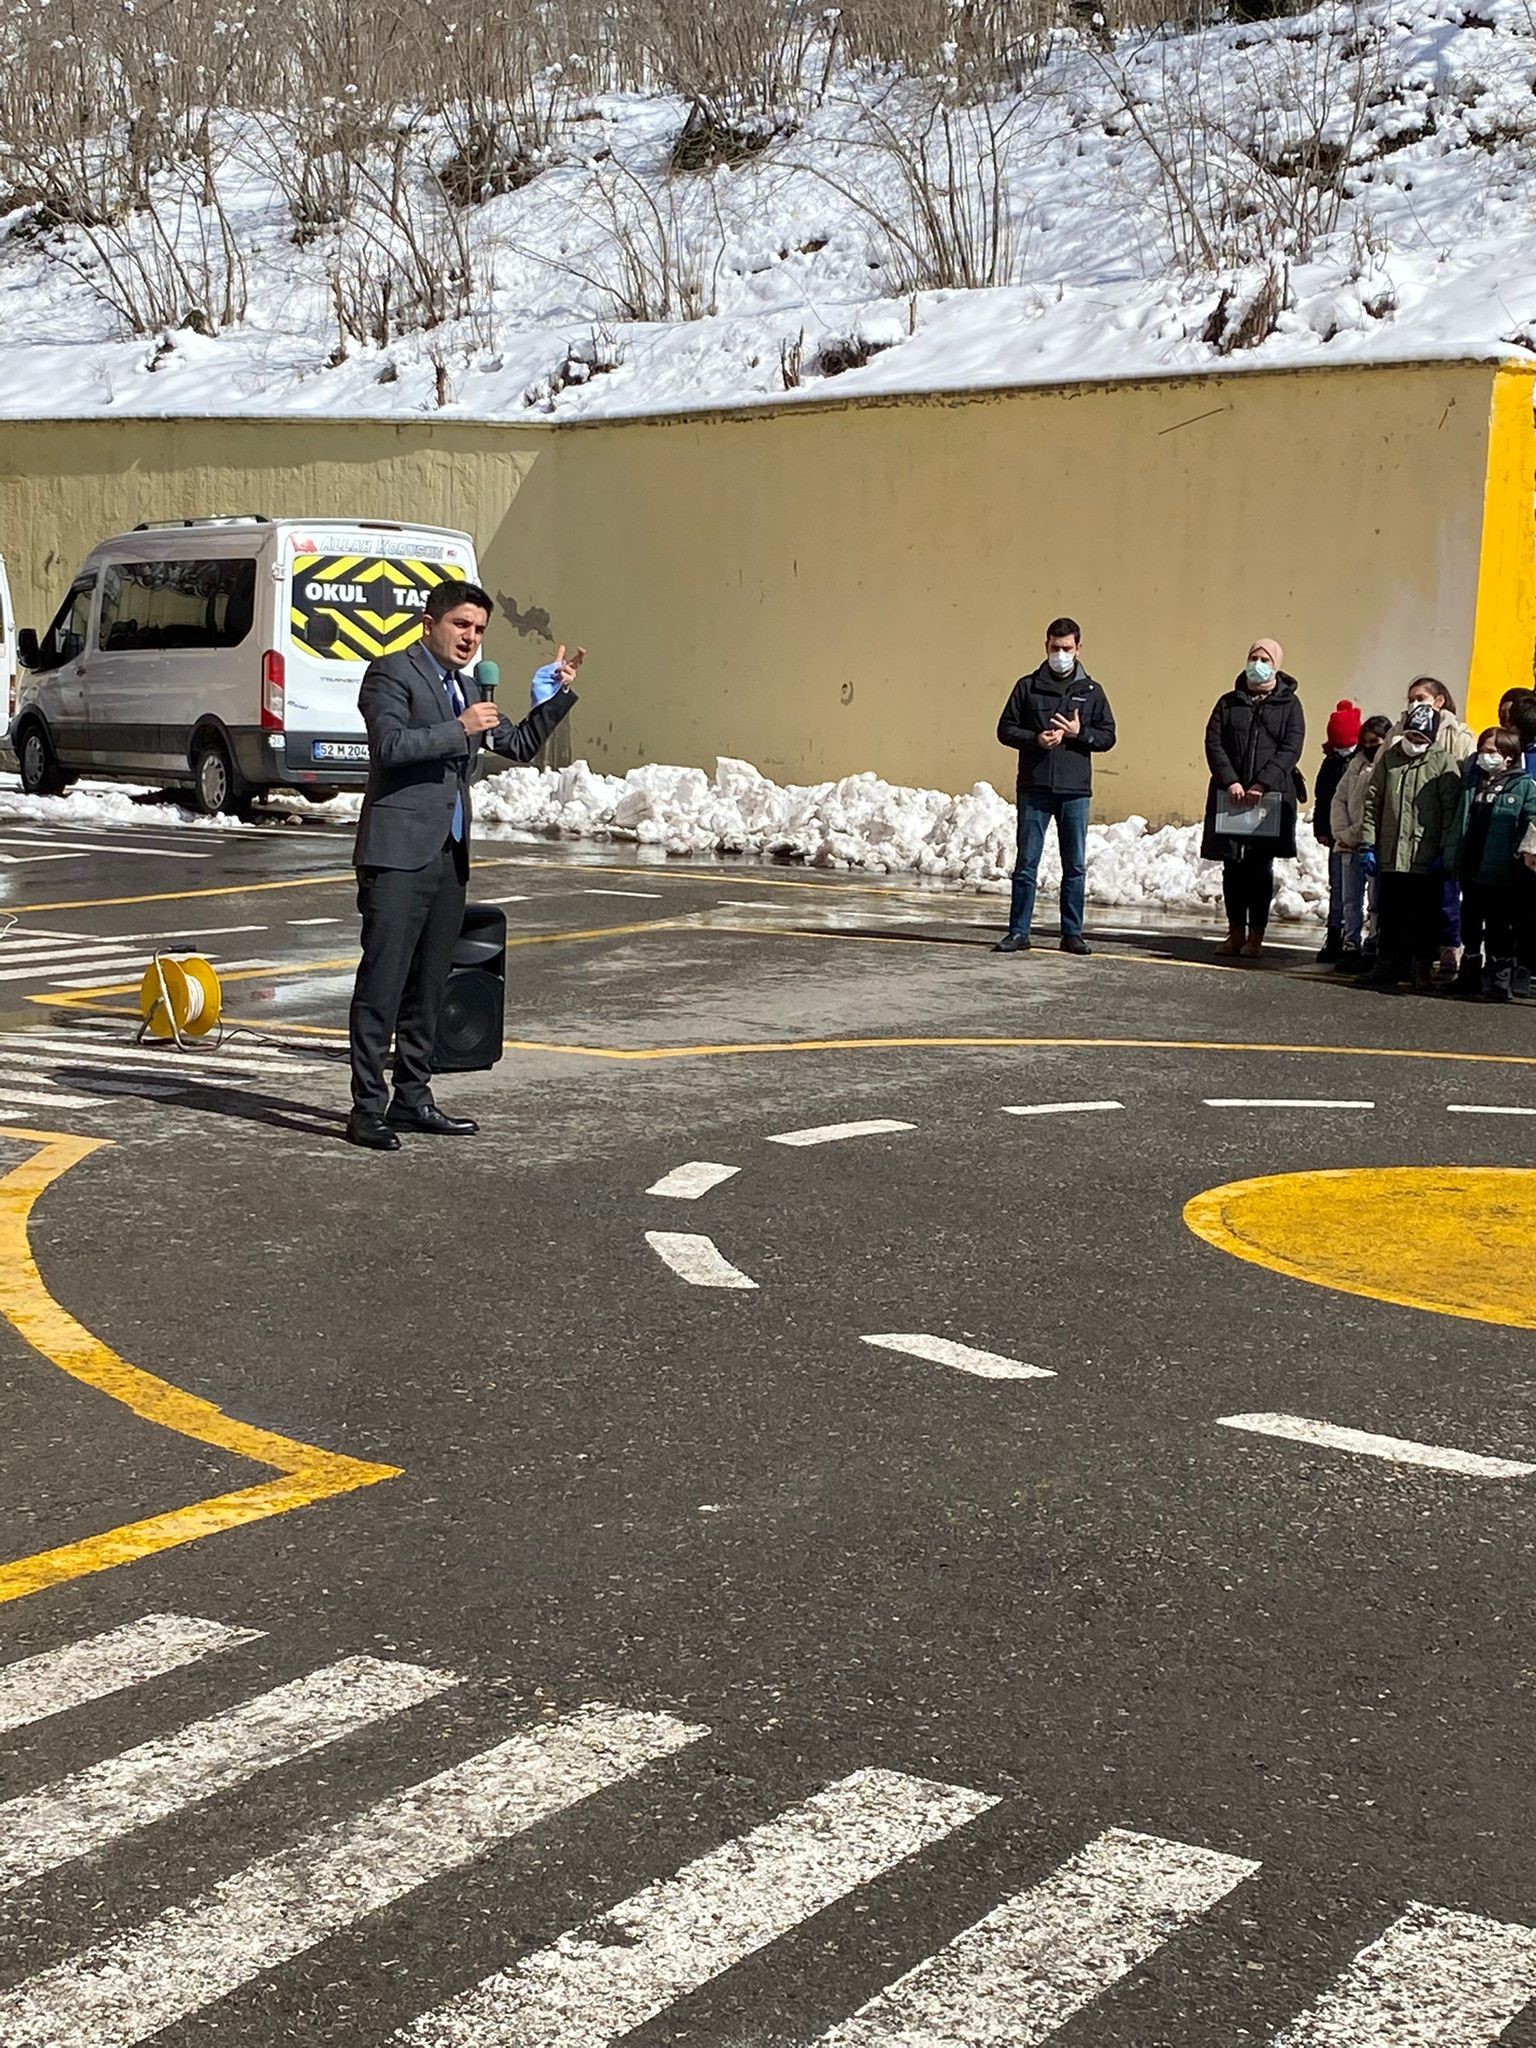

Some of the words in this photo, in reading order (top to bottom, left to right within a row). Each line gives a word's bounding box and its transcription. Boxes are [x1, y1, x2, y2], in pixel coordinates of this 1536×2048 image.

[320, 536, 372, 553] ALLAH
[305, 582, 367, 603] OKUL
[393, 588, 431, 611] TAŞ
[321, 744, 334, 756] 52
[348, 745, 369, 757] 204
